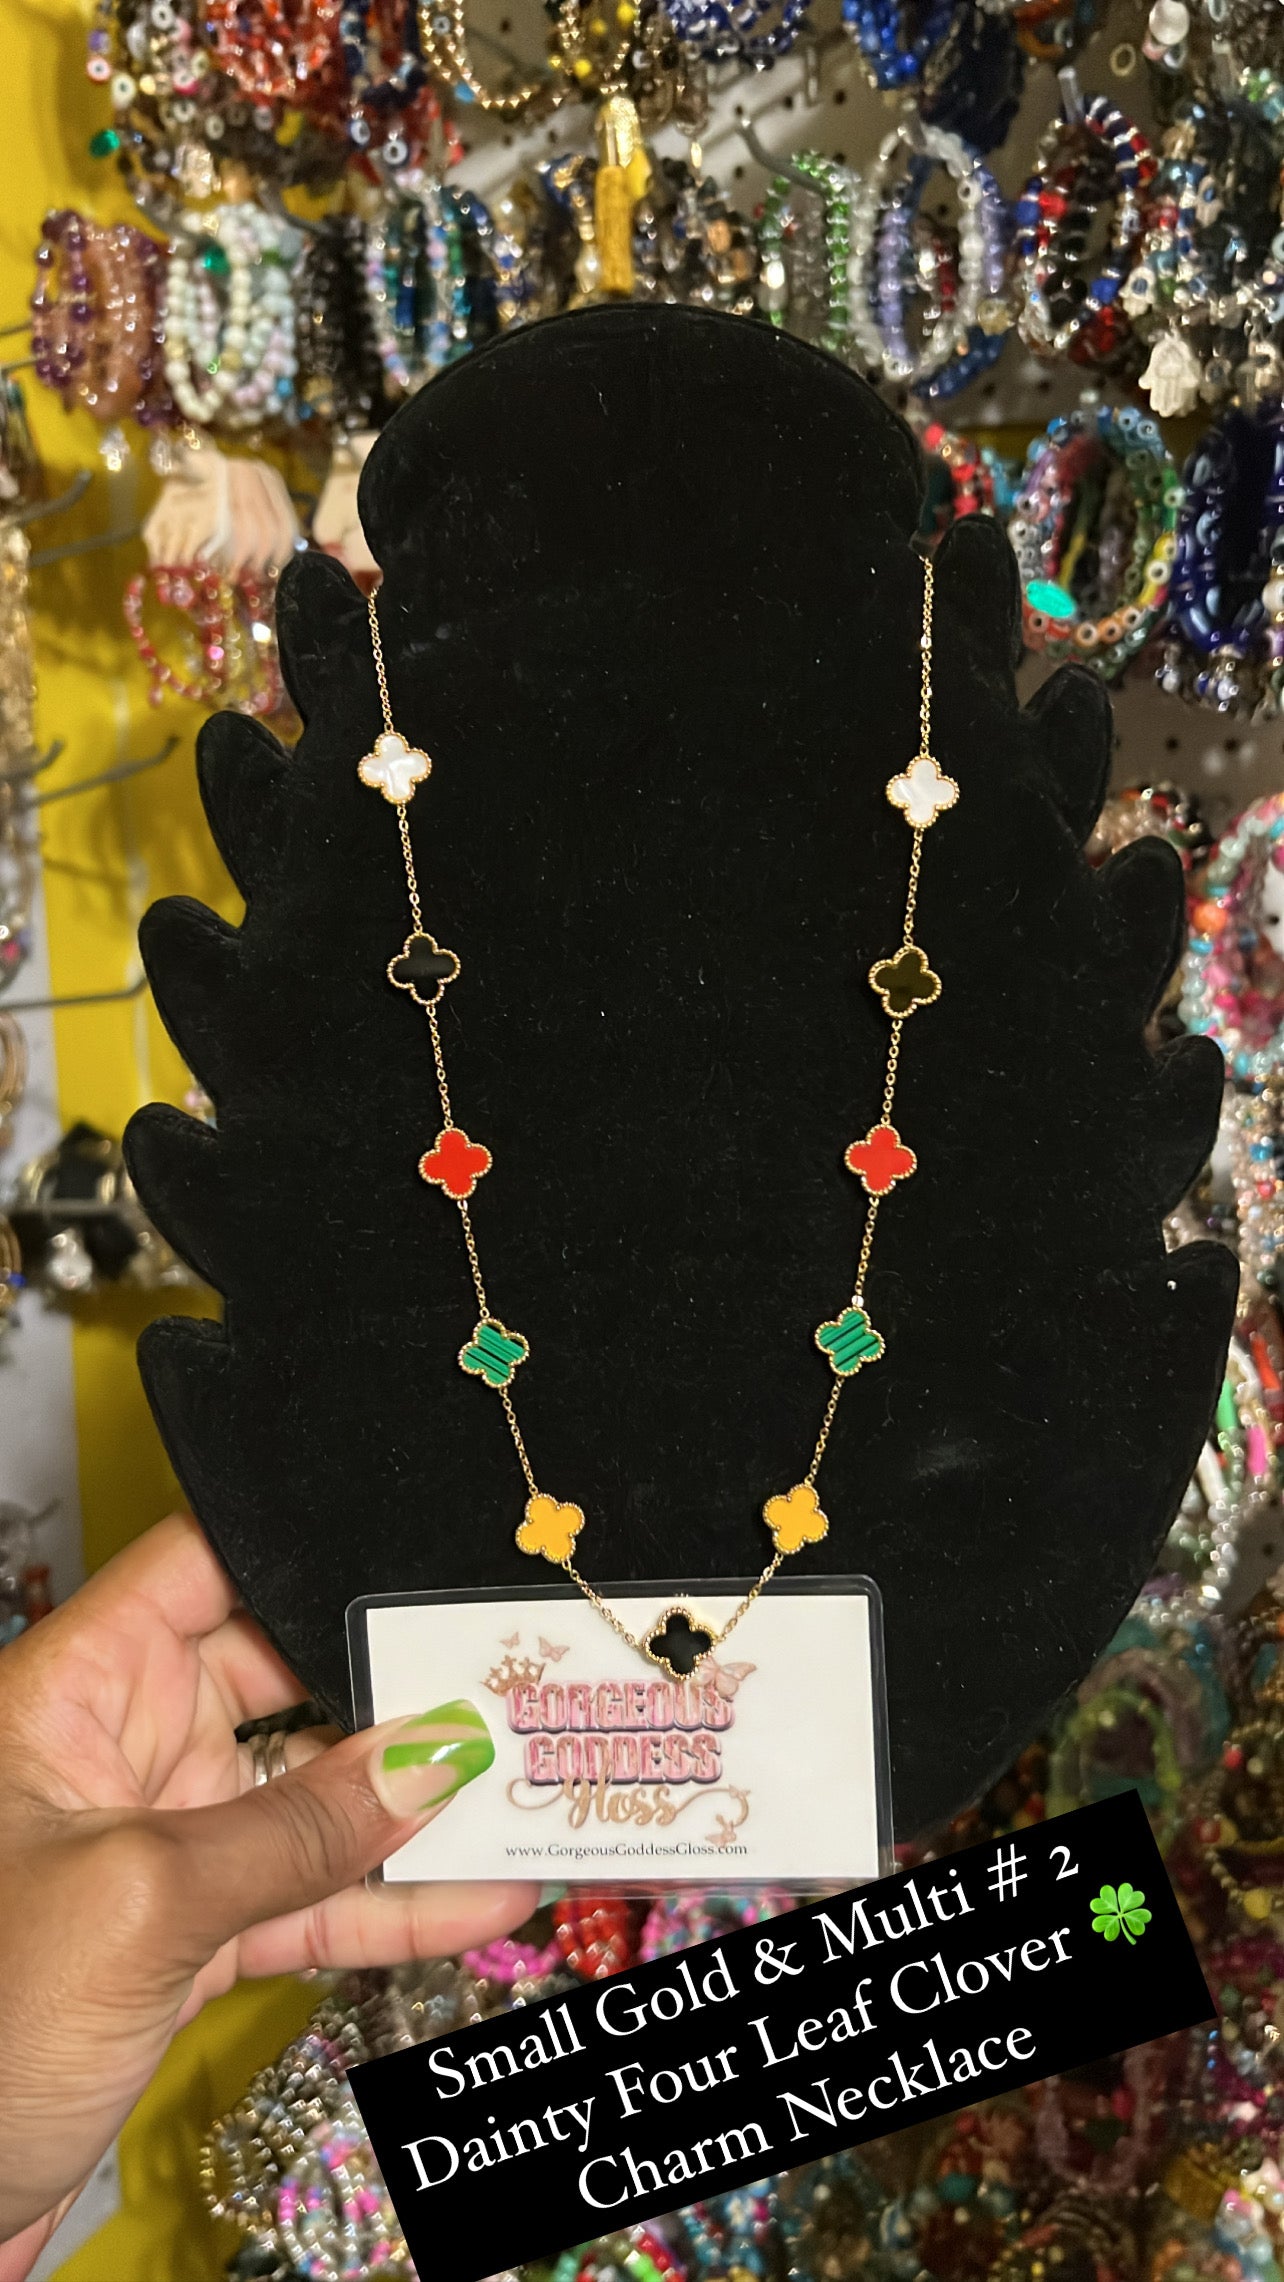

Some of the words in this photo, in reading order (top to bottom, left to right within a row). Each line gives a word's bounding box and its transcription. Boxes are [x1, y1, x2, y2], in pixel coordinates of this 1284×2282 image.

[508, 1680, 735, 1731] GORGEOUS
[523, 1732, 723, 1784] GODDESS
[505, 1843, 747, 1860] www.GorgeousGoddessGloss.com
